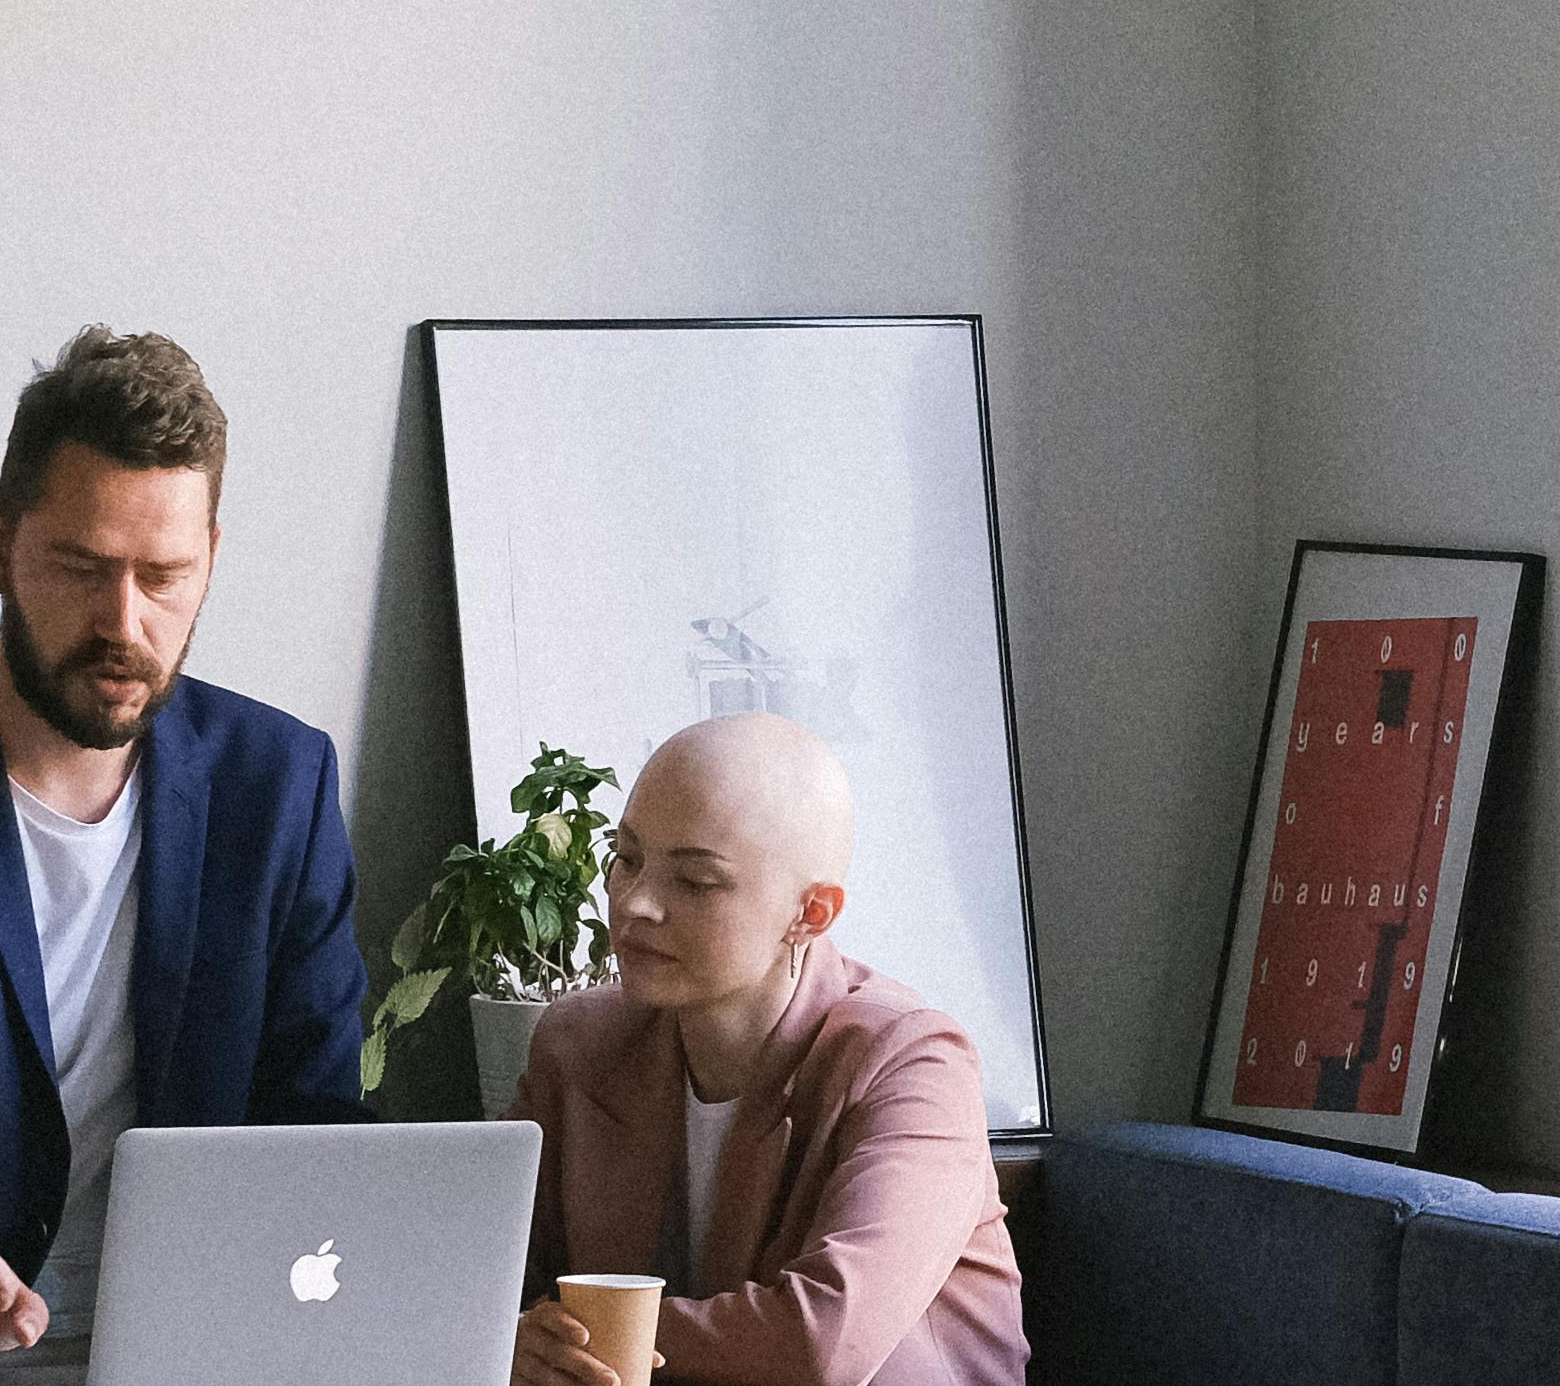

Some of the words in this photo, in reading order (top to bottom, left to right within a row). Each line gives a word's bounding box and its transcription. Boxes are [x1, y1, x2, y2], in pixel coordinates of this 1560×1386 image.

[1295, 719, 1455, 753] years
[1285, 794, 1446, 827] of
[1271, 873, 1430, 909] bauhaus
